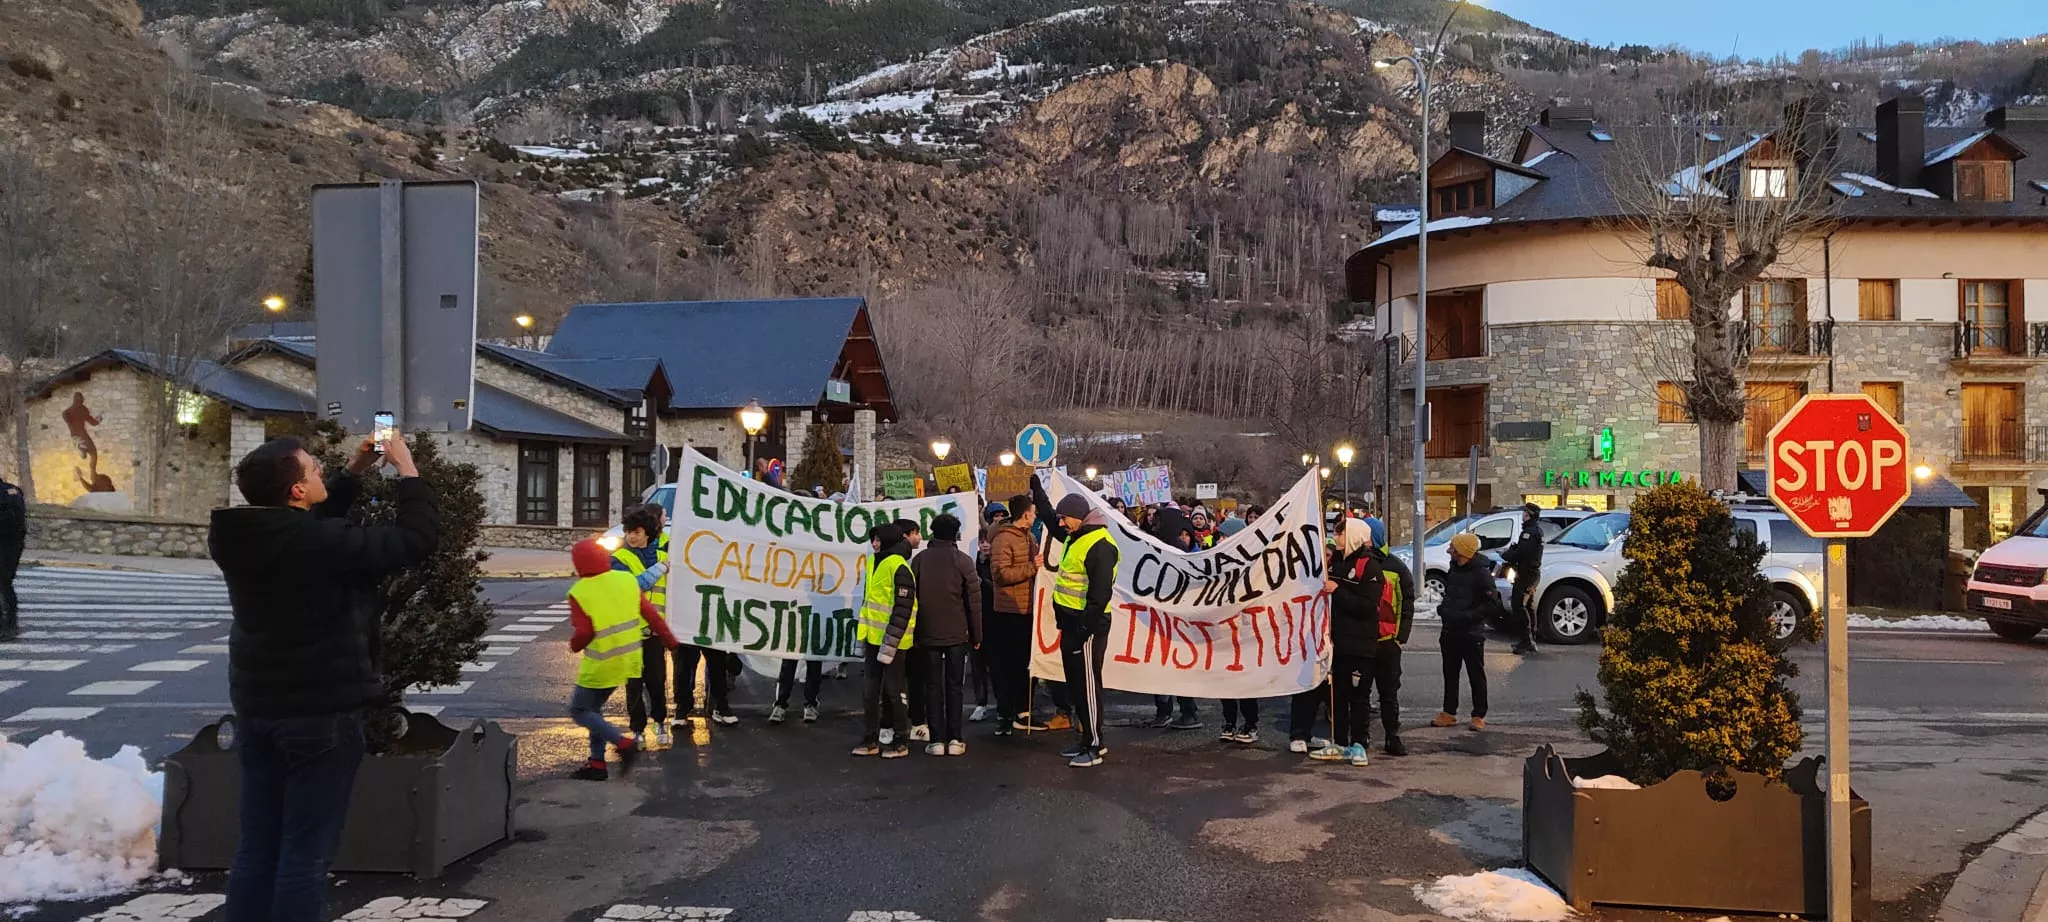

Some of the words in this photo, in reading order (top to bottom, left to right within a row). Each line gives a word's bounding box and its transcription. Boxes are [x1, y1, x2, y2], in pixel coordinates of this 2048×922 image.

[1116, 466, 1167, 484] JUNTS
[1776, 440, 1902, 491] STOP
[1132, 524, 1324, 606] COMUNIDAD
[1114, 588, 1330, 671] INSTITUTO
